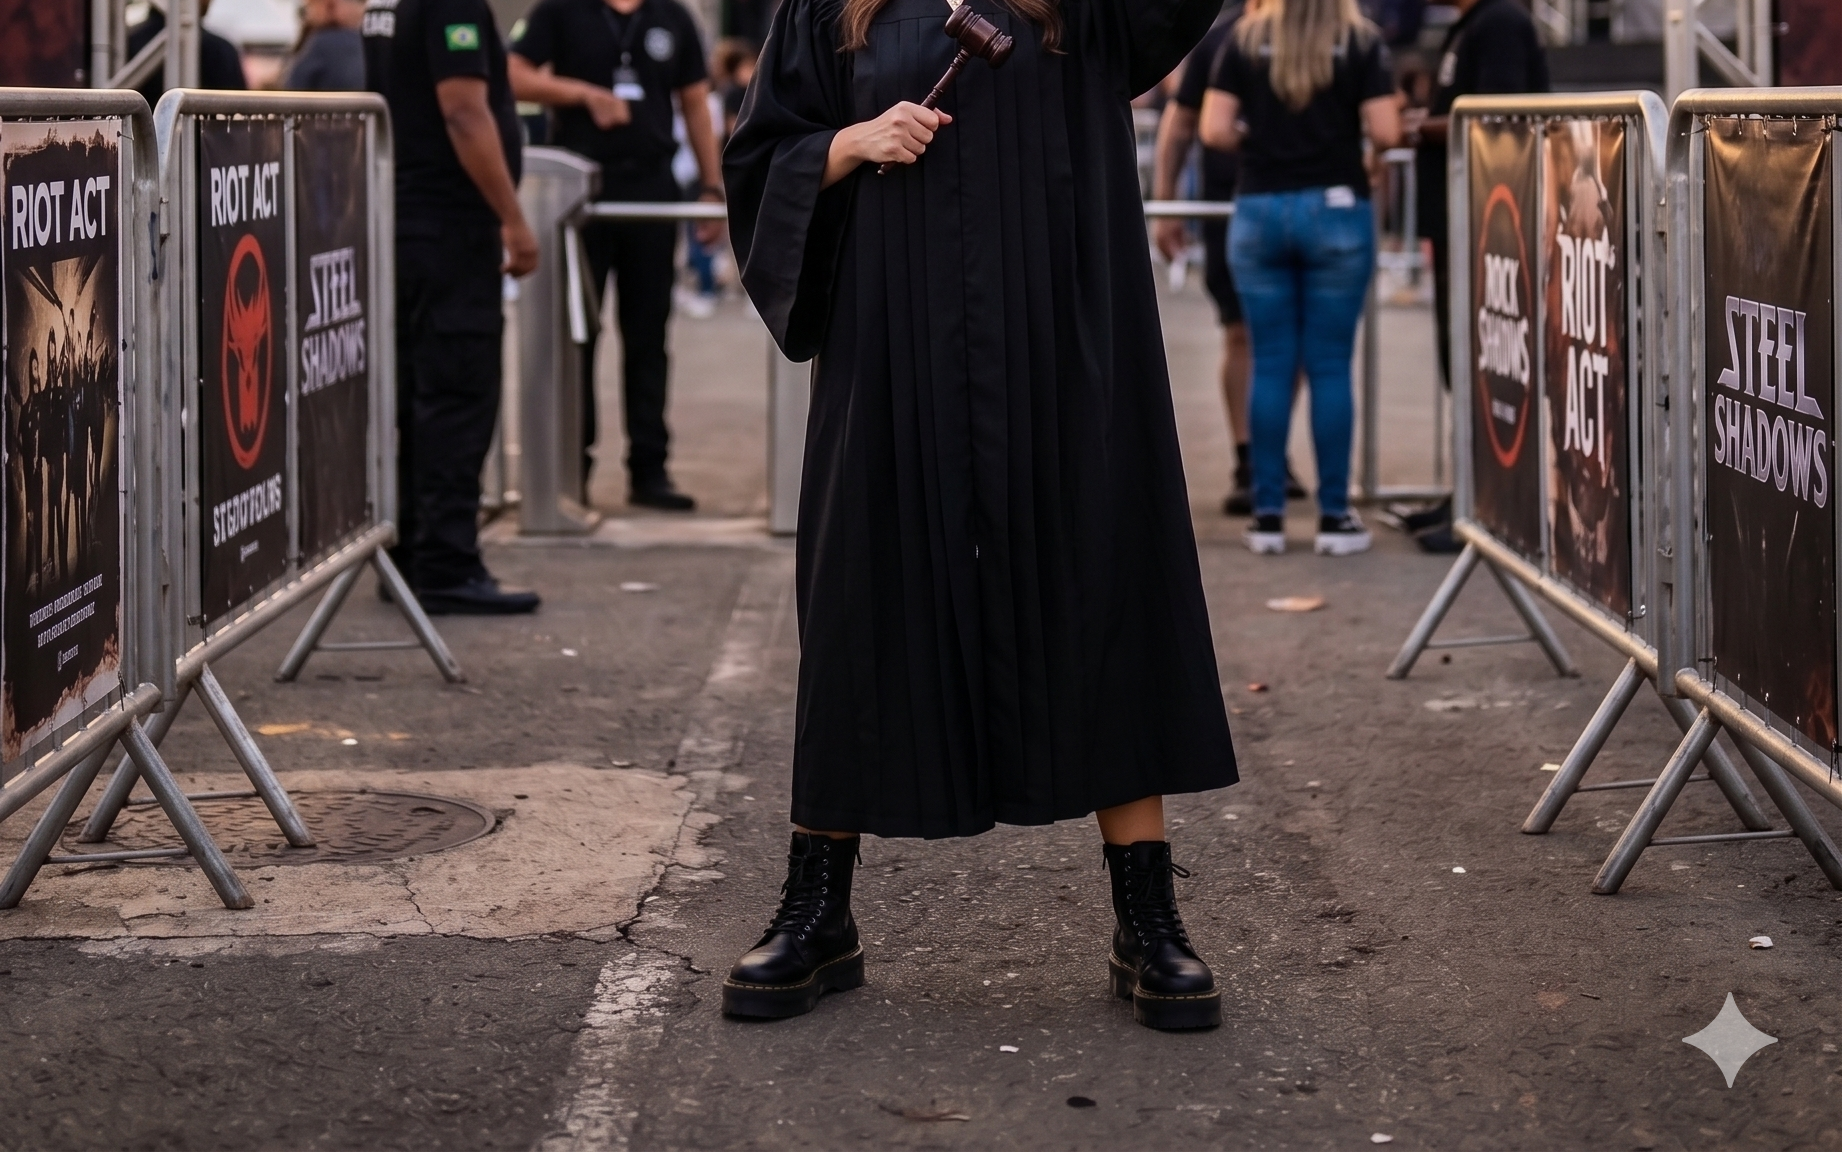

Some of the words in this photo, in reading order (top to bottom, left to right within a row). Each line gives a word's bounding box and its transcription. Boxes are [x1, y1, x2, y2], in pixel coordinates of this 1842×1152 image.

[12, 180, 65, 250] RIOT
[69, 175, 110, 241] ACT
[211, 164, 250, 227] RIOT
[252, 161, 280, 221] ACT
[1557, 228, 1614, 348] RIOT
[1564, 345, 1609, 476] ACT
[1717, 295, 1825, 420] STEEL
[1714, 394, 1828, 508] SHADOWS
